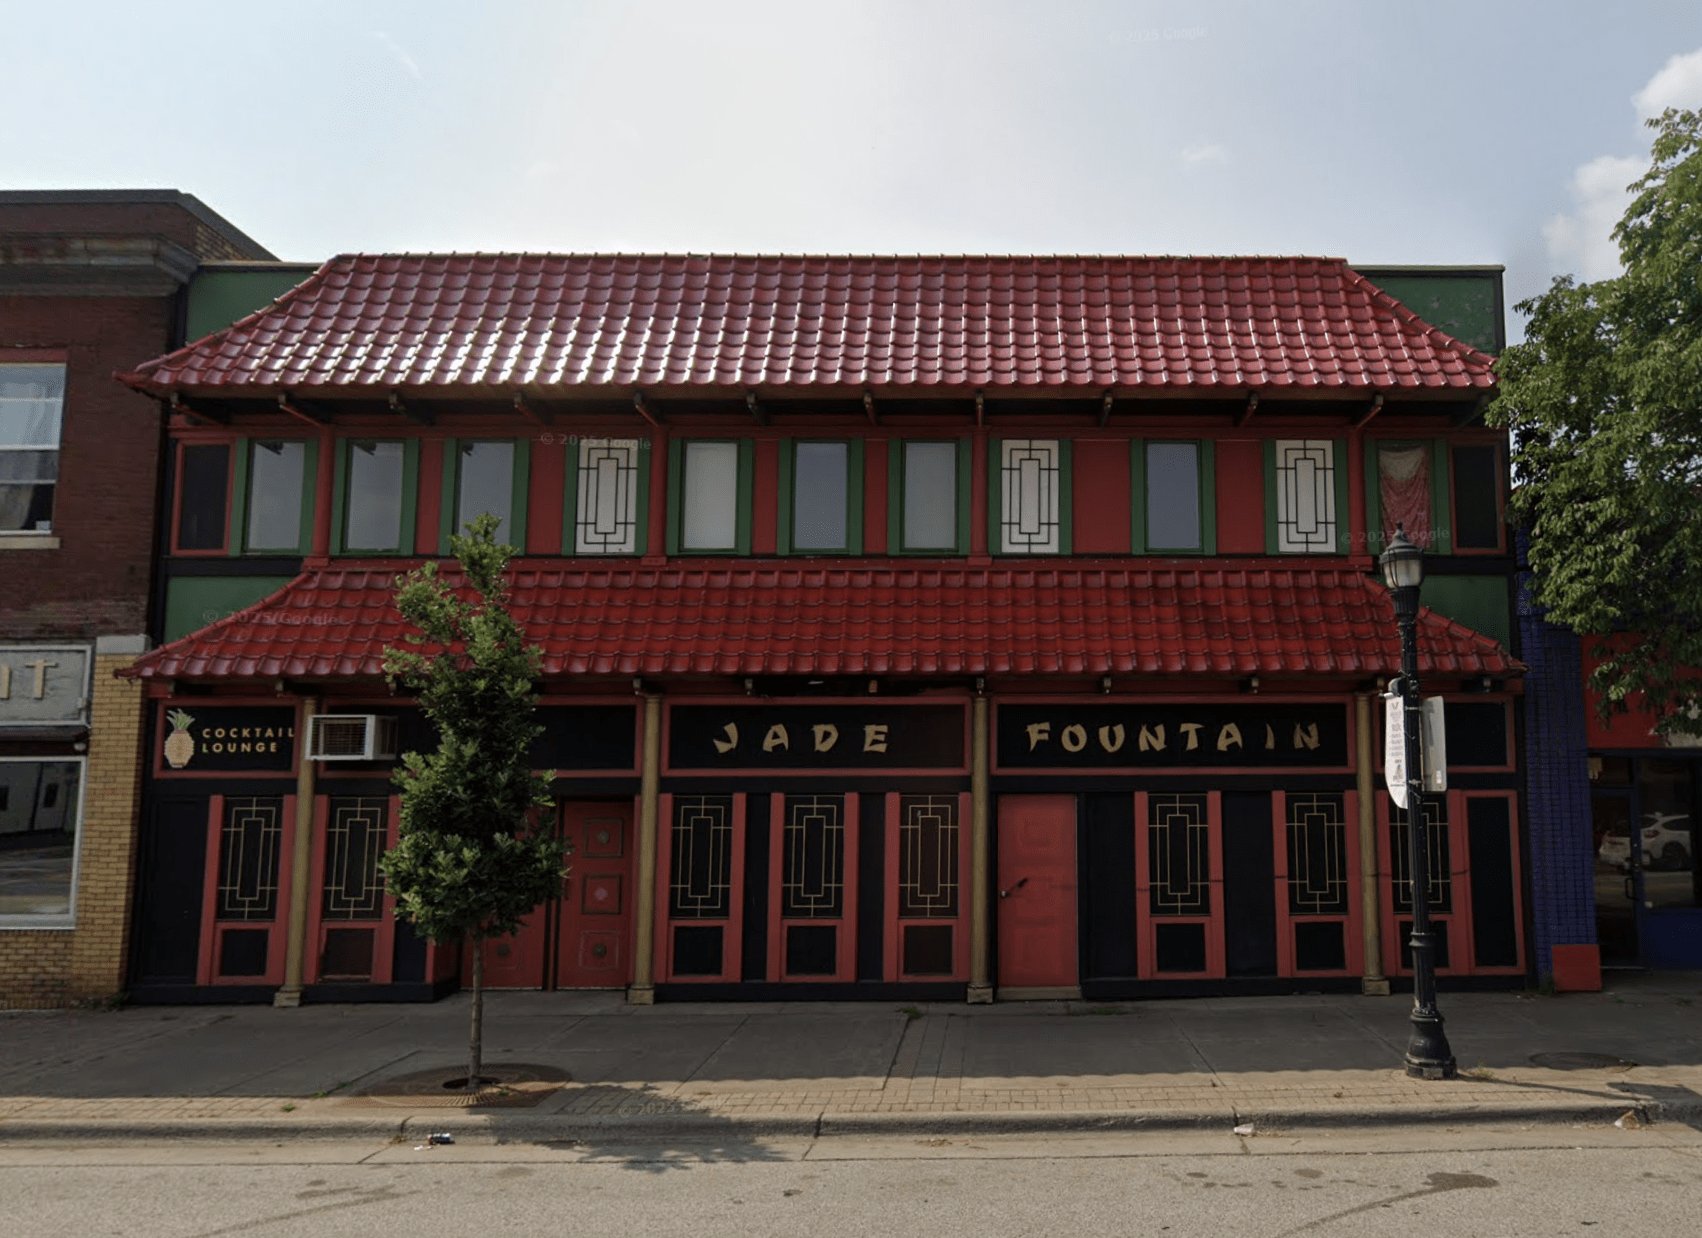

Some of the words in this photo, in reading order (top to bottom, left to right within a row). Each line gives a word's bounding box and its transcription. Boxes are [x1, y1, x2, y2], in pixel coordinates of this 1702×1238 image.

[202, 727, 295, 738] COCKTAIL
[713, 722, 888, 753] JADE
[1026, 721, 1321, 753] FOUNTAIN
[202, 742, 277, 753] LOUNGE
